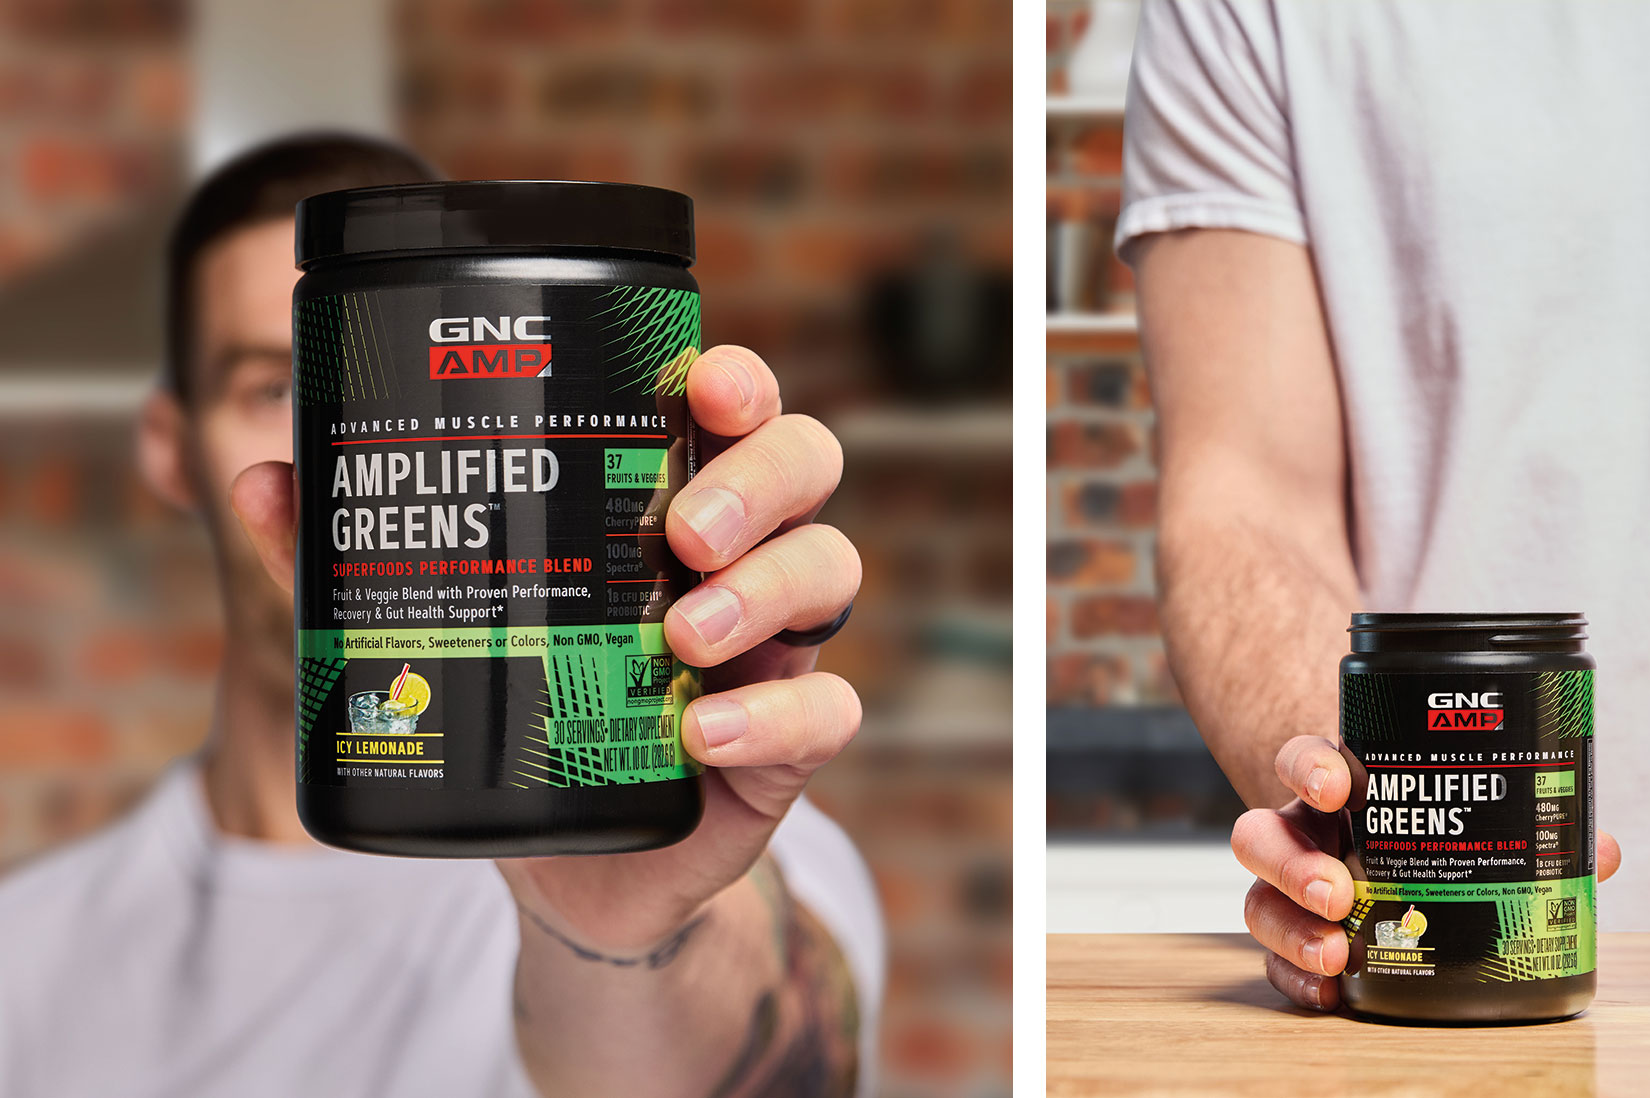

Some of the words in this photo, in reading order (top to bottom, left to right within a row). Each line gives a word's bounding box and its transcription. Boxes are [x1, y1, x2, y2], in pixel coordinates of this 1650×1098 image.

[429, 316, 551, 342] GNC
[437, 350, 542, 374] AMP
[331, 418, 419, 435] ADVANCED
[435, 415, 518, 430] MUSCLE
[535, 414, 666, 428] PERFORMANCE
[607, 454, 622, 469] 37
[332, 449, 560, 498] AMPLIFIED
[607, 473, 632, 483] FRUITS
[634, 473, 640, 483] &
[642, 473, 666, 483] VEGGIES
[606, 498, 644, 513] 480MG
[606, 543, 642, 559] 100MG
[332, 561, 413, 577] SUPERFOODS
[420, 559, 537, 576] PERFORMANCE
[544, 558, 592, 573] BLEND
[333, 588, 352, 600] Fruit
[355, 588, 362, 600] &
[365, 588, 398, 604] Veggie
[402, 586, 433, 600] Blend
[437, 586, 462, 599] with
[466, 586, 508, 599] Proven
[512, 584, 592, 598] Performance,
[607, 588, 619, 603] 1B
[622, 592, 637, 602] CFU
[334, 608, 371, 624] Recovery
[375, 607, 382, 619] &
[386, 606, 404, 619] Gut
[408, 605, 444, 619] Health
[607, 605, 650, 616] PROBIOTIC
[334, 637, 344, 649] No
[346, 636, 383, 649] Artificial
[386, 636, 425, 650] Flavors,
[429, 636, 492, 648] Sweeteners
[496, 638, 507, 647] or
[511, 635, 549, 648] Colors,
[553, 634, 576, 646] Non
[577, 633, 602, 646] GMO,
[605, 633, 634, 647] Vegan
[653, 658, 670, 667] NON
[653, 668, 670, 676] GMO
[630, 686, 670, 696] VERIFIED
[1428, 692, 1503, 708] GNC
[1432, 713, 1498, 727] AMP
[554, 720, 564, 744] 30
[567, 719, 606, 744] SERVINGS
[610, 717, 638, 741] DIETARY
[639, 714, 675, 740] SUPPLEMENT
[336, 740, 352, 754] ICY
[356, 741, 424, 755] LEMONADE
[604, 747, 617, 772] NET
[620, 746, 631, 771] WT.
[633, 746, 640, 770] 10
[1366, 753, 1421, 762] ADVANCED
[1431, 753, 1483, 762] MUSCLE
[1493, 750, 1574, 761] PERFORMANCE
[337, 768, 350, 776] WITH
[352, 768, 373, 777] OTHER
[374, 768, 407, 778] NATURAL
[409, 768, 444, 778] FLAVORS
[1366, 774, 1507, 801] AMPLIFIED
[1537, 776, 1546, 786] 37
[1536, 802, 1559, 812] 480MG
[1536, 831, 1558, 840] 100MG
[1366, 840, 1416, 851] SUPERFOODS
[1420, 841, 1493, 851] PERFORMANCE
[1497, 840, 1527, 850] BLEND
[1366, 856, 1378, 865] Fruit
[1380, 856, 1384, 865] &
[1386, 857, 1408, 868] Veggie
[1410, 857, 1429, 866] Blend
[1431, 857, 1447, 866] with
[1449, 858, 1475, 866] Proven
[1478, 857, 1526, 866] Performance,
[1366, 868, 1390, 879] Recovery
[1392, 869, 1397, 878] &
[1399, 869, 1411, 878] Gut
[1412, 870, 1436, 878] Health
[1536, 868, 1562, 876] PROBIOTIC
[1373, 886, 1398, 895] Artificial
[1399, 888, 1424, 897] Flavors,
[1426, 889, 1465, 897] Sweeteners
[1476, 888, 1500, 896] Colors,
[1517, 887, 1533, 895] GMO,
[1534, 886, 1552, 895] Vegan
[1502, 940, 1509, 955] 30
[1367, 950, 1378, 959] ICY
[1380, 951, 1423, 962] LEMONADE
